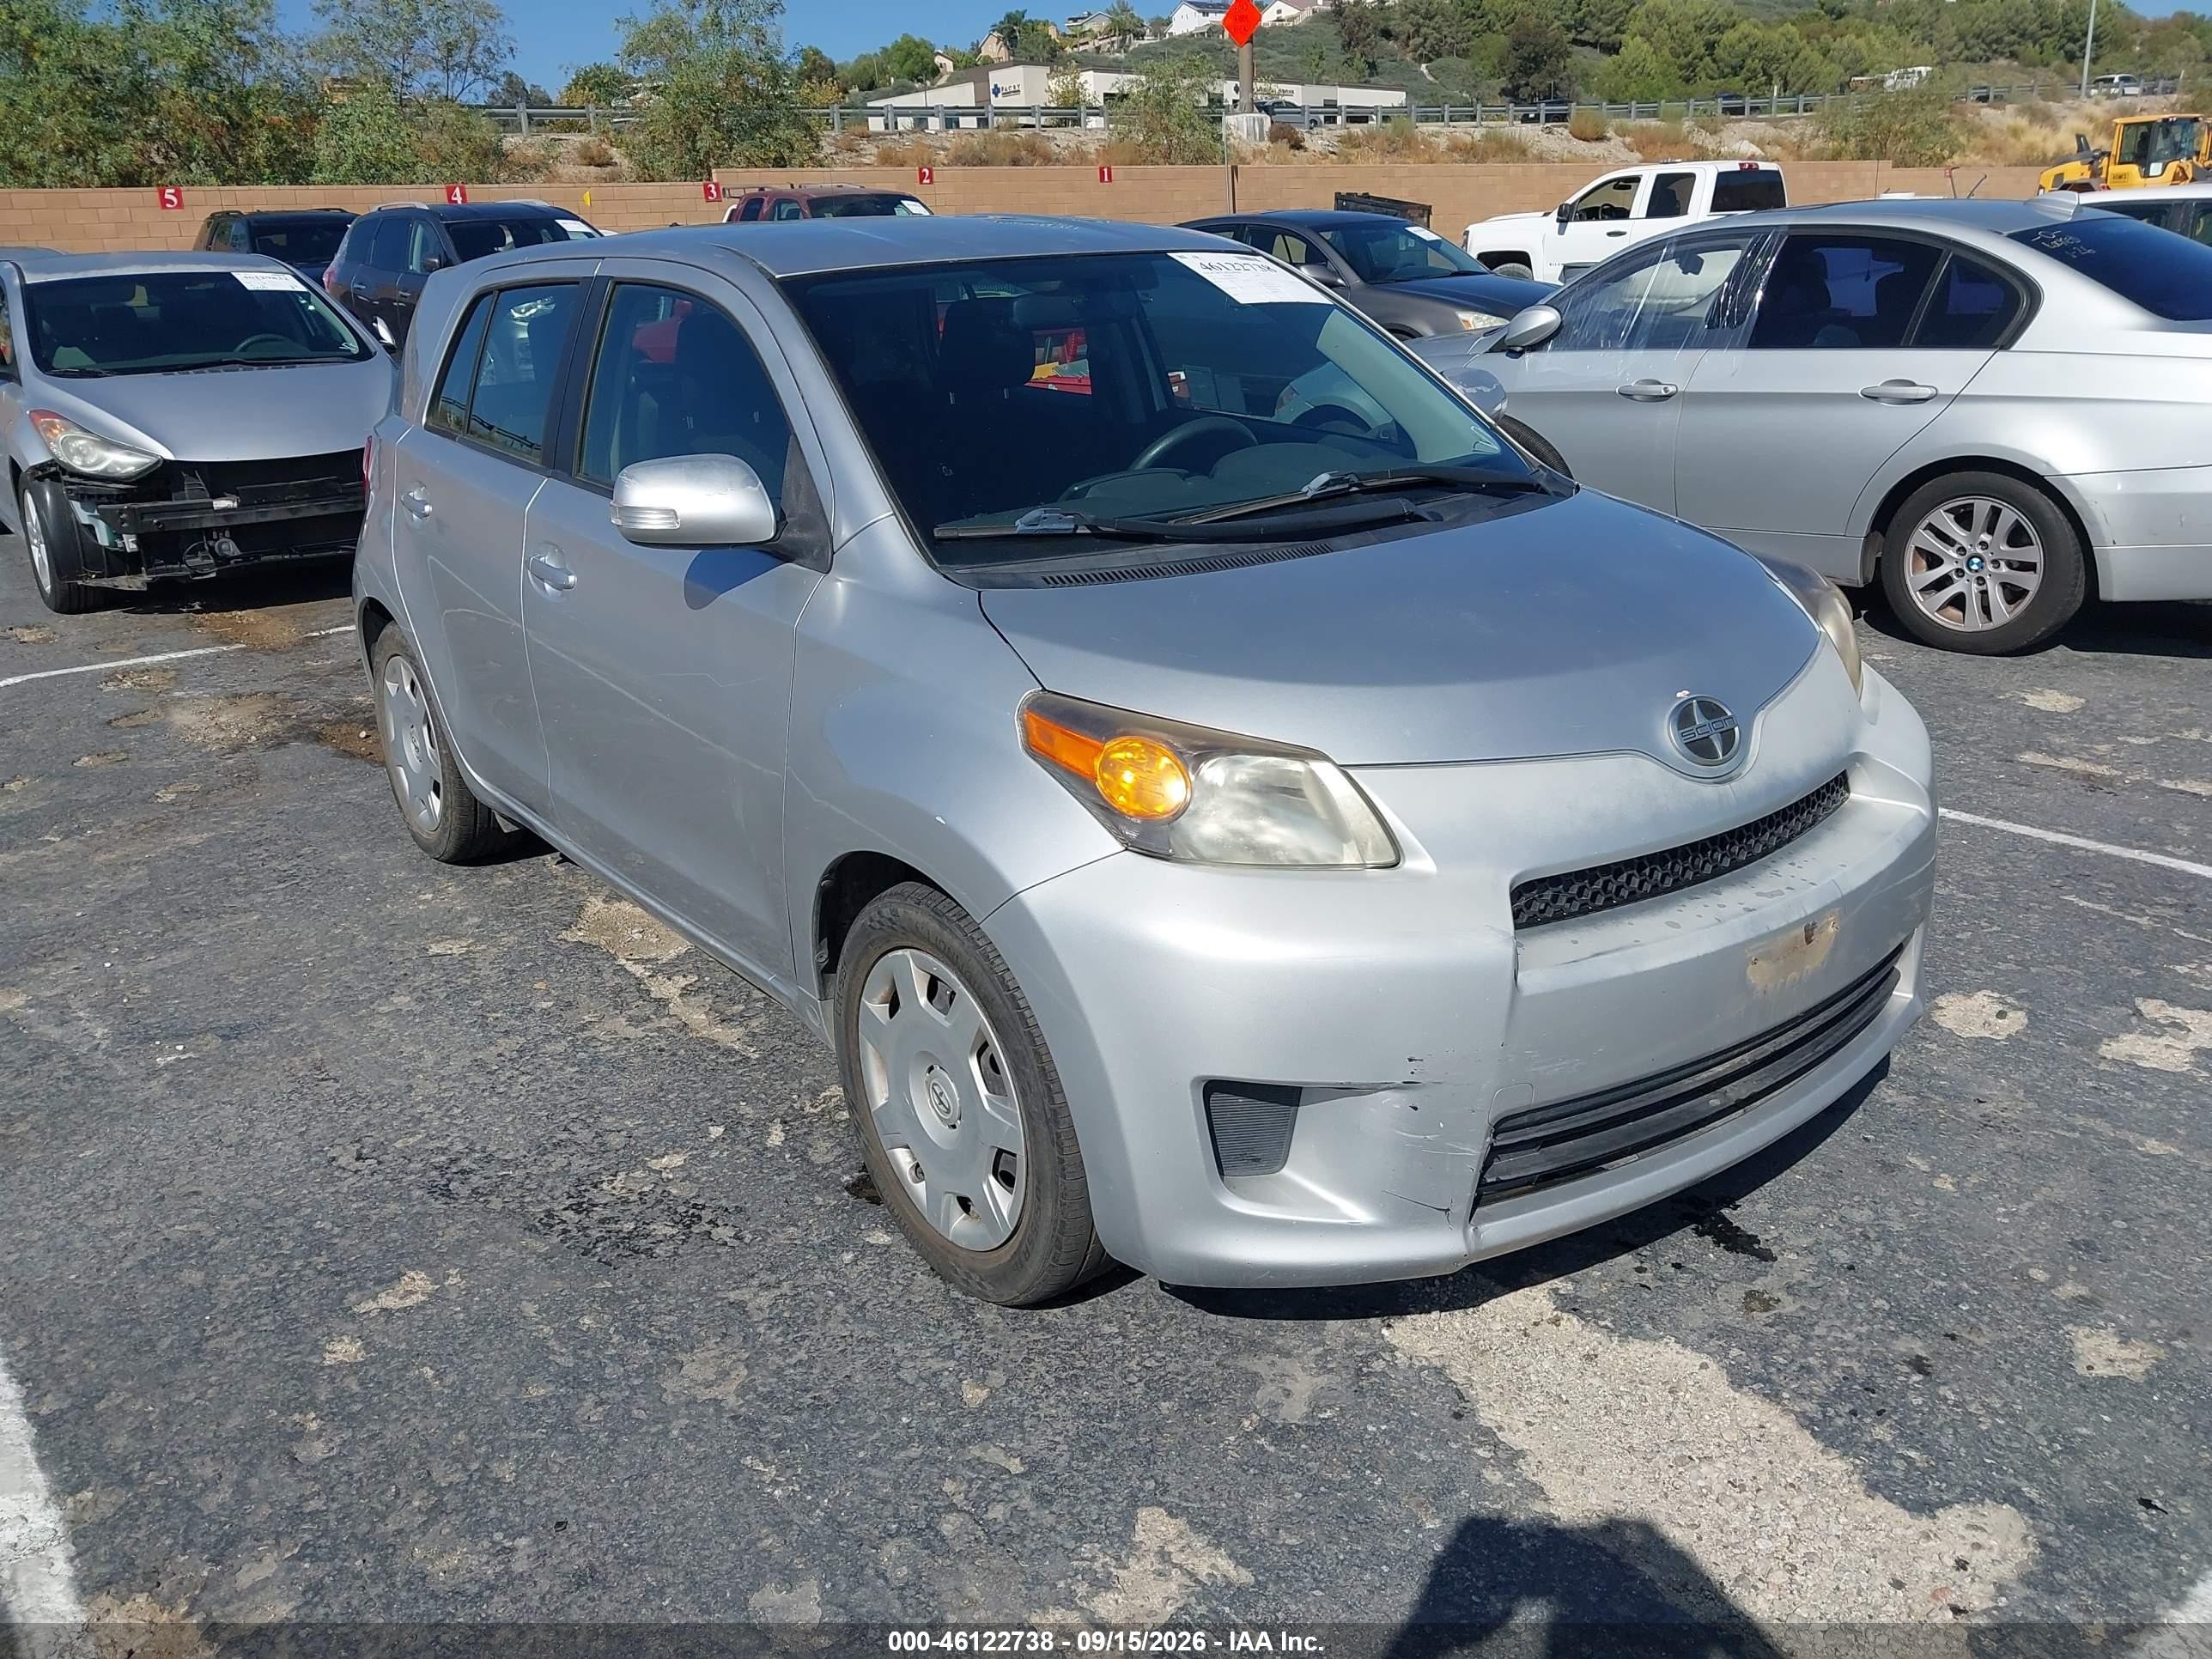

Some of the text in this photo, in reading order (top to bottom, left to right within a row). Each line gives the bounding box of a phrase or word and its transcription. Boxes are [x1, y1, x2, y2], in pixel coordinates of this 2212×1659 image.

[921, 167, 930, 184] 2
[1103, 167, 1109, 181] 1
[164, 188, 178, 207] 5
[451, 186, 463, 204] 4
[707, 183, 718, 200] 3
[1200, 262, 1276, 273] 46122738
[1680, 718, 1735, 741] SCION
